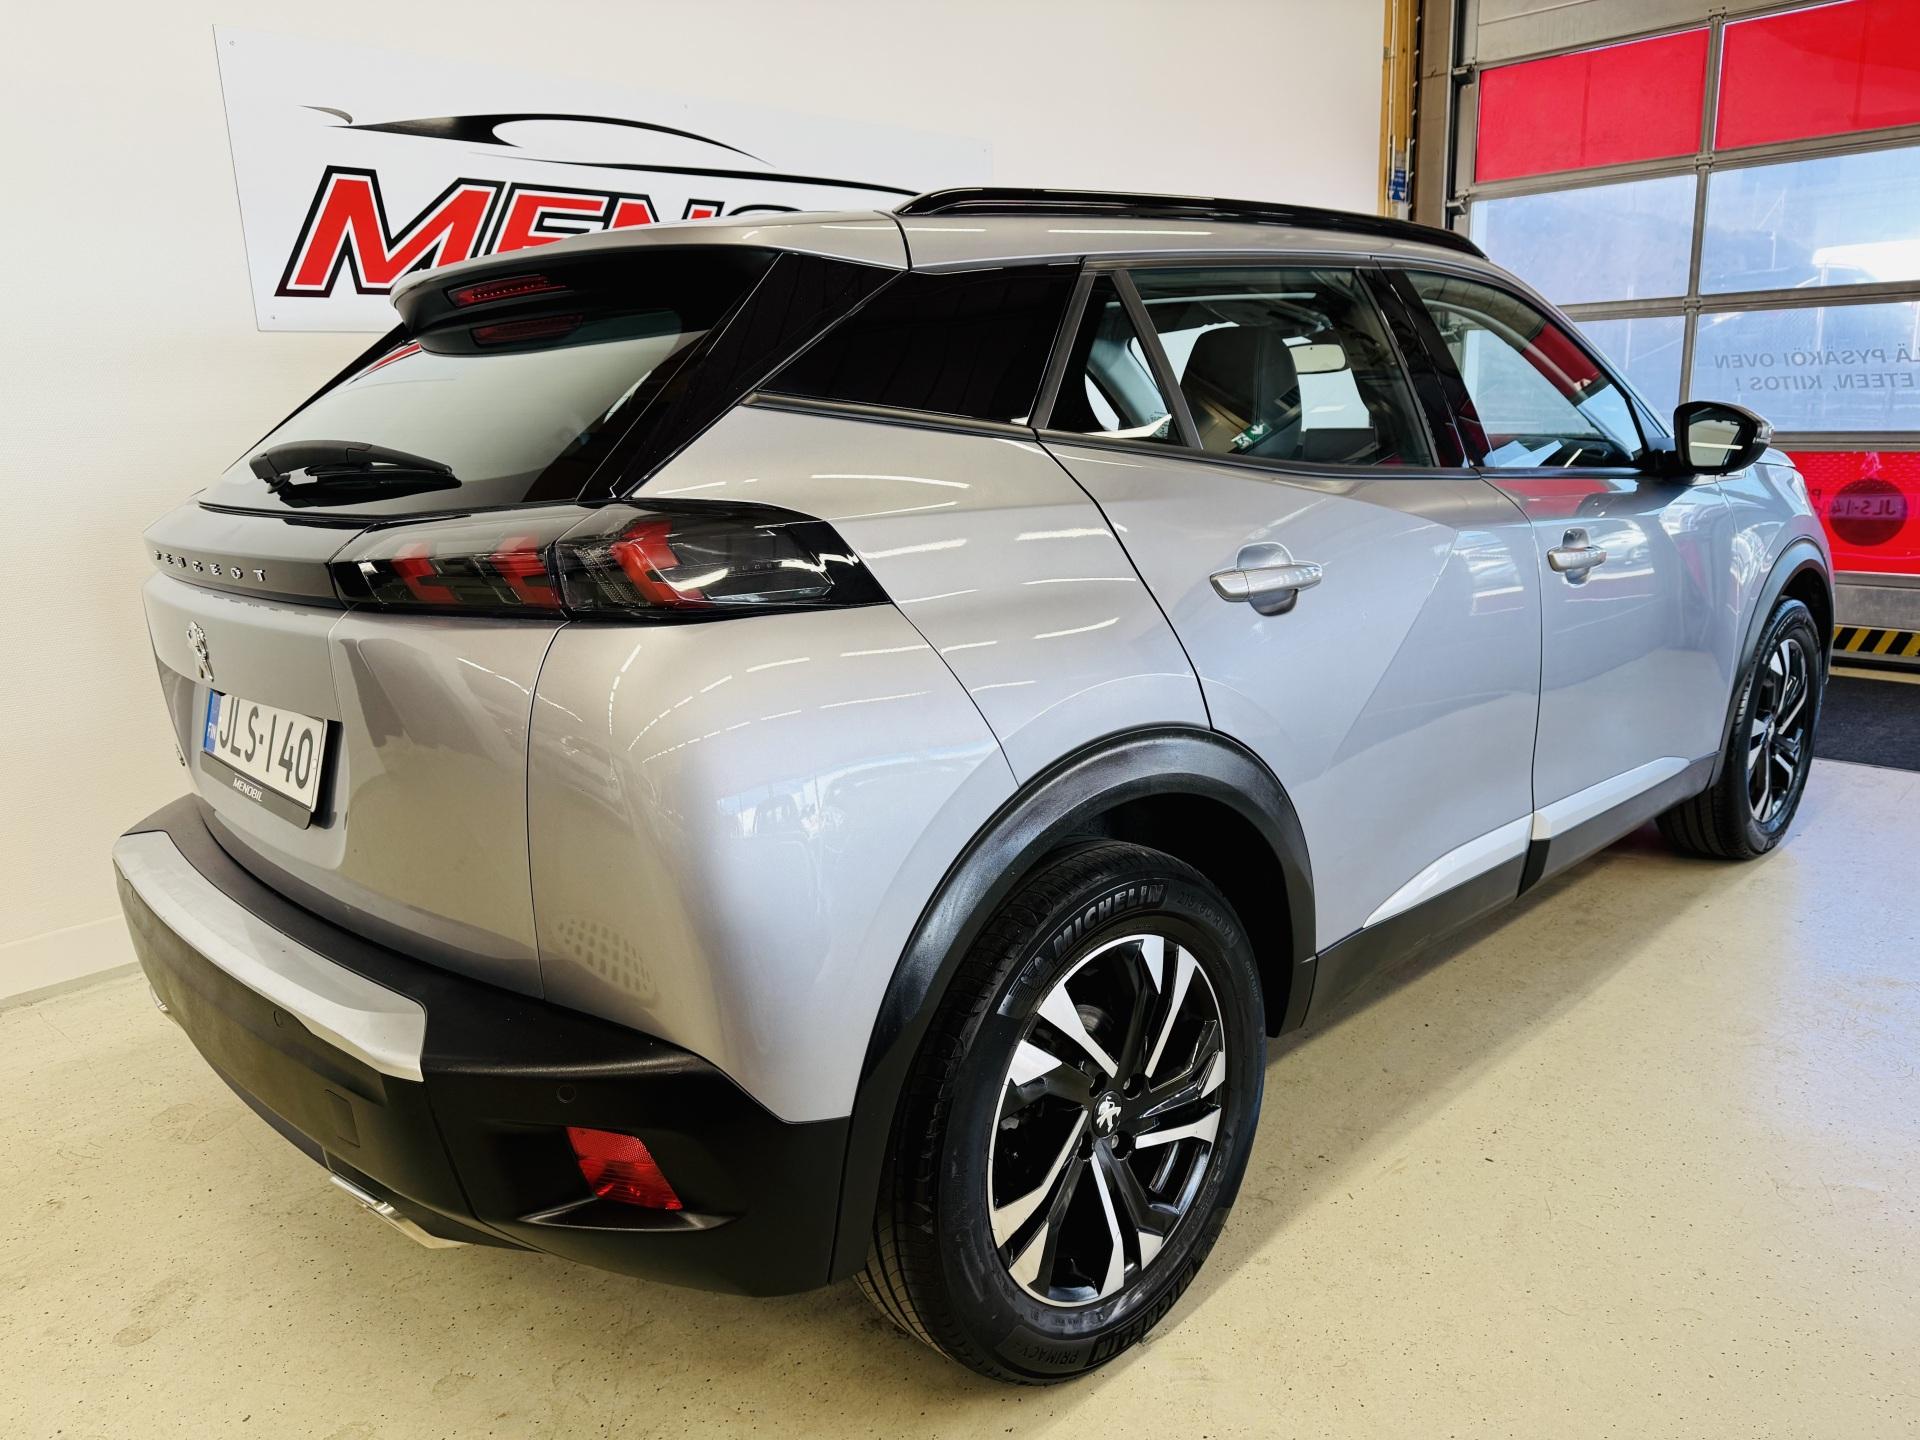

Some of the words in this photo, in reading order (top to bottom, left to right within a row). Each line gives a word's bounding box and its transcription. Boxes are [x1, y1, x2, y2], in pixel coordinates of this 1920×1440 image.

[153, 549, 268, 582] PEUGEOT
[219, 696, 314, 790] JLS-140
[232, 778, 263, 803] MENOBIL
[1053, 884, 1165, 959] MICHELIN
